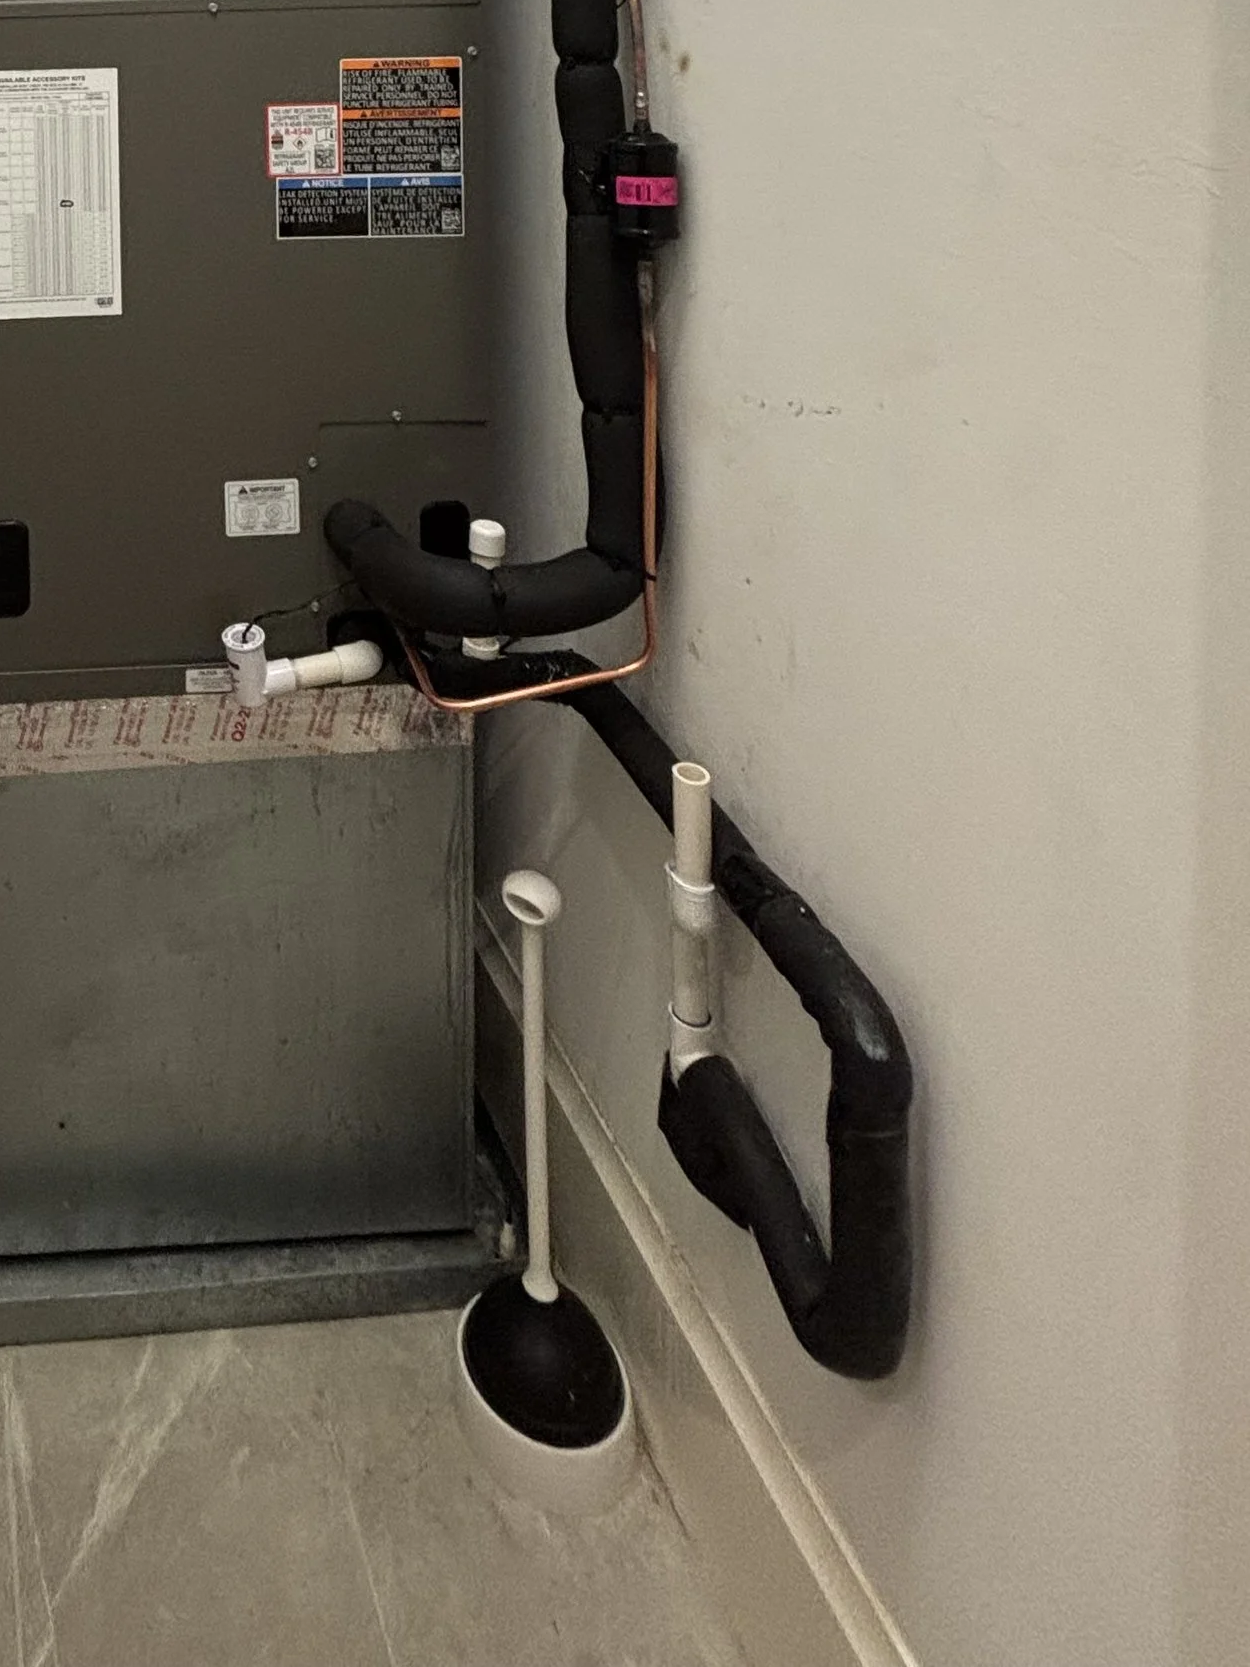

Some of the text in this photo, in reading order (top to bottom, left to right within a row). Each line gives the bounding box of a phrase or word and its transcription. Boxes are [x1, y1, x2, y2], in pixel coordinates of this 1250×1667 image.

[300, 189, 338, 198] DETECTION
[346, 197, 367, 206] MUST
[292, 206, 332, 215] POWERED
[336, 205, 366, 214] EXCEPT
